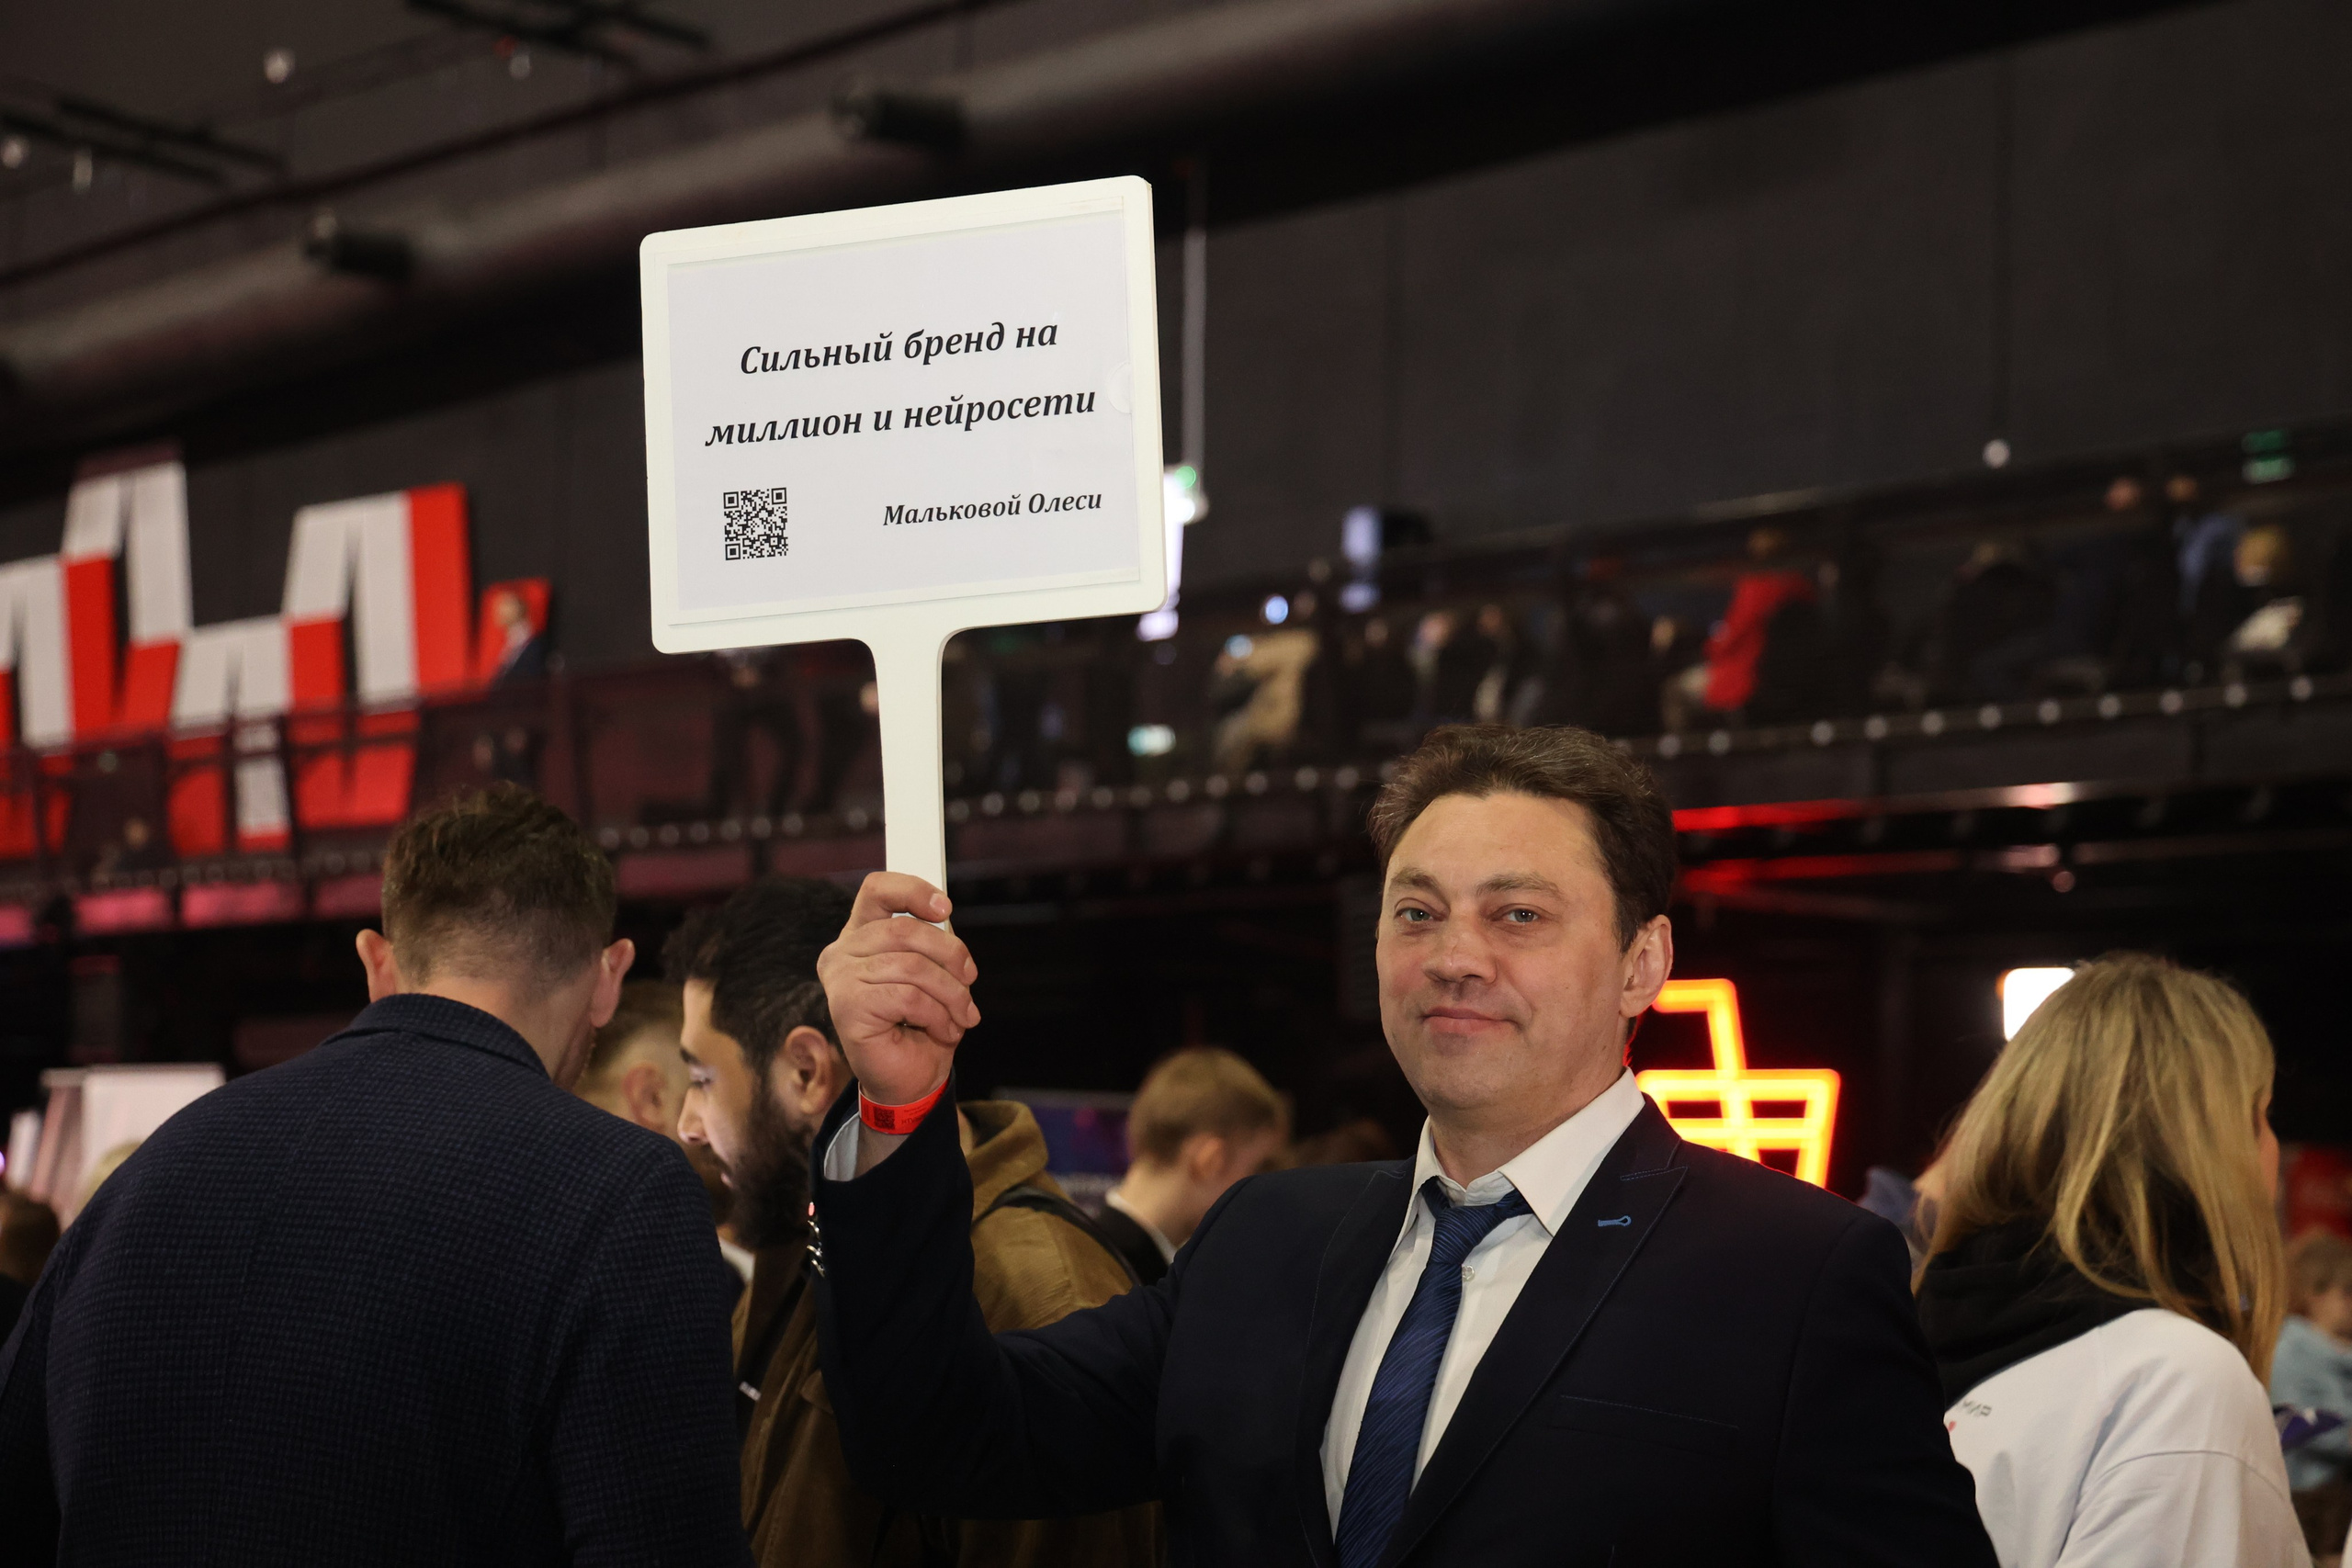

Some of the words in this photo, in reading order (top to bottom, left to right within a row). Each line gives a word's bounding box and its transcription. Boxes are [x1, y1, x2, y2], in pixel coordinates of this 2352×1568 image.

[741, 331, 894, 376] Сильный
[904, 321, 1006, 366] бренд
[1015, 323, 1059, 350] на
[704, 411, 864, 448] миллион
[872, 409, 895, 433] и
[903, 390, 1097, 433] нейросети
[882, 493, 1023, 526] Мальковой
[1027, 491, 1102, 515] Олеси
